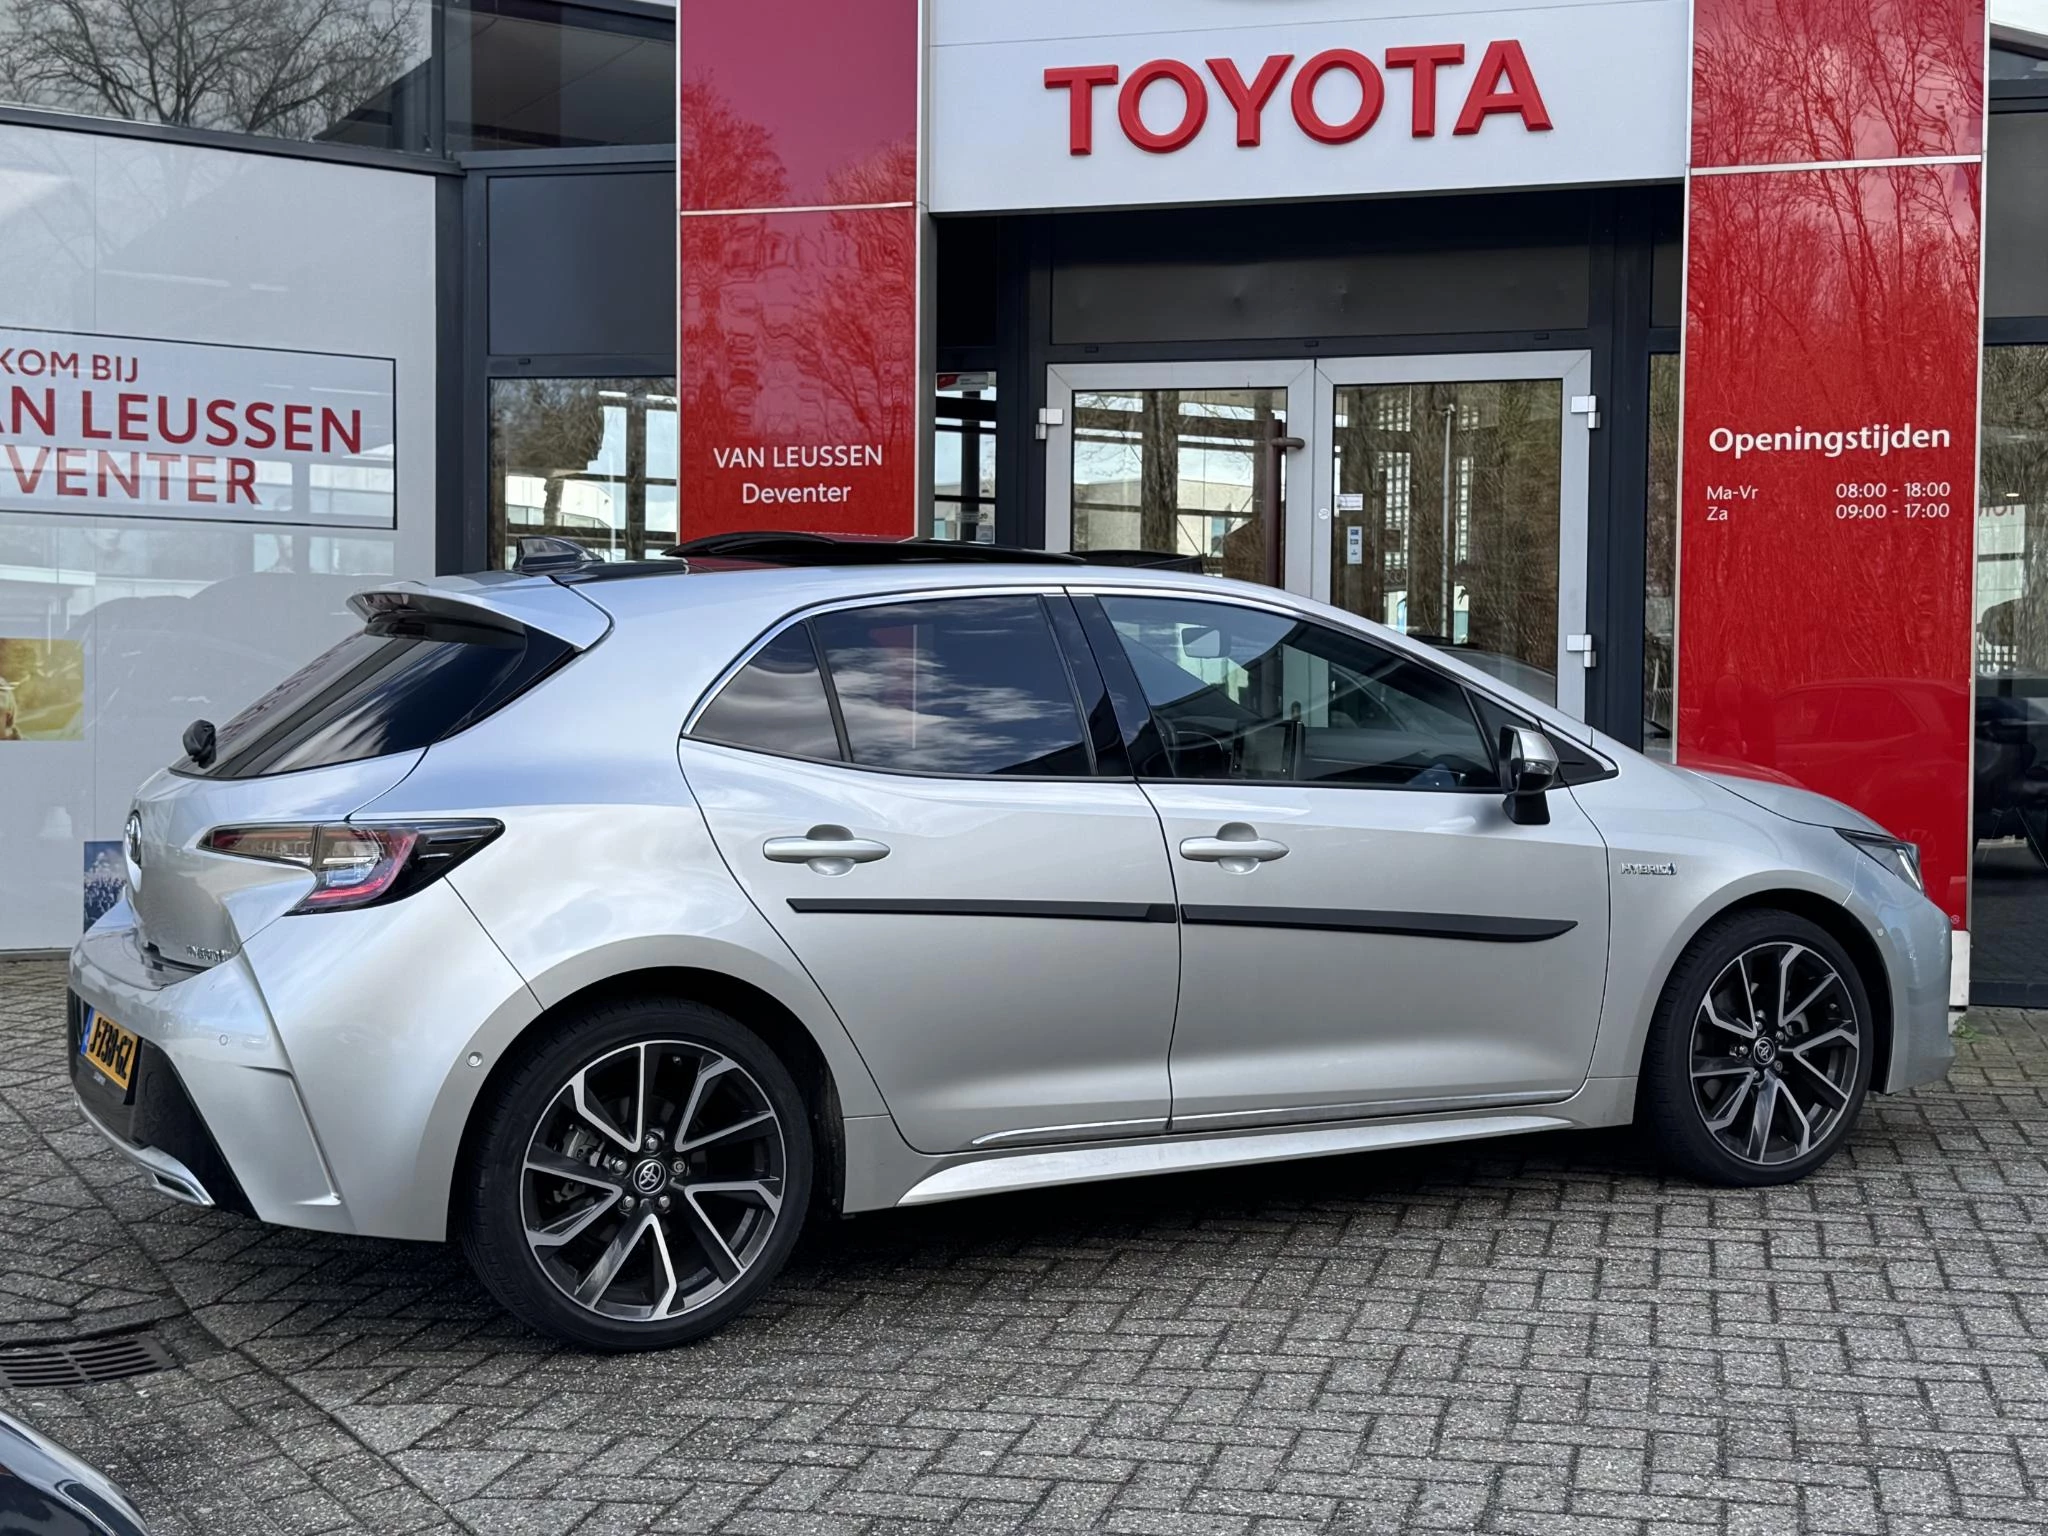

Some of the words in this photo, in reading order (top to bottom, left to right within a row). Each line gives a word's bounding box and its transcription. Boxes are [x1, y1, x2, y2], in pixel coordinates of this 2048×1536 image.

[1044, 39, 1554, 156] TOYOTA
[92, 354, 138, 382] BIJ
[0, 386, 55, 436] N
[82, 390, 361, 454] LEUSSEN
[1709, 423, 1950, 459] Openingstijden
[713, 447, 765, 468] VAN
[773, 445, 882, 467] LEUSSEN
[5, 444, 262, 505] VENTER
[742, 483, 851, 504] Deventer
[1706, 485, 1759, 500] Ma-Vr
[1836, 483, 1887, 498] 08:00
[1904, 482, 1950, 497] 18:00
[1706, 506, 1728, 521] Za
[1836, 504, 1887, 519] 09:00
[1904, 503, 1950, 518] 17:00
